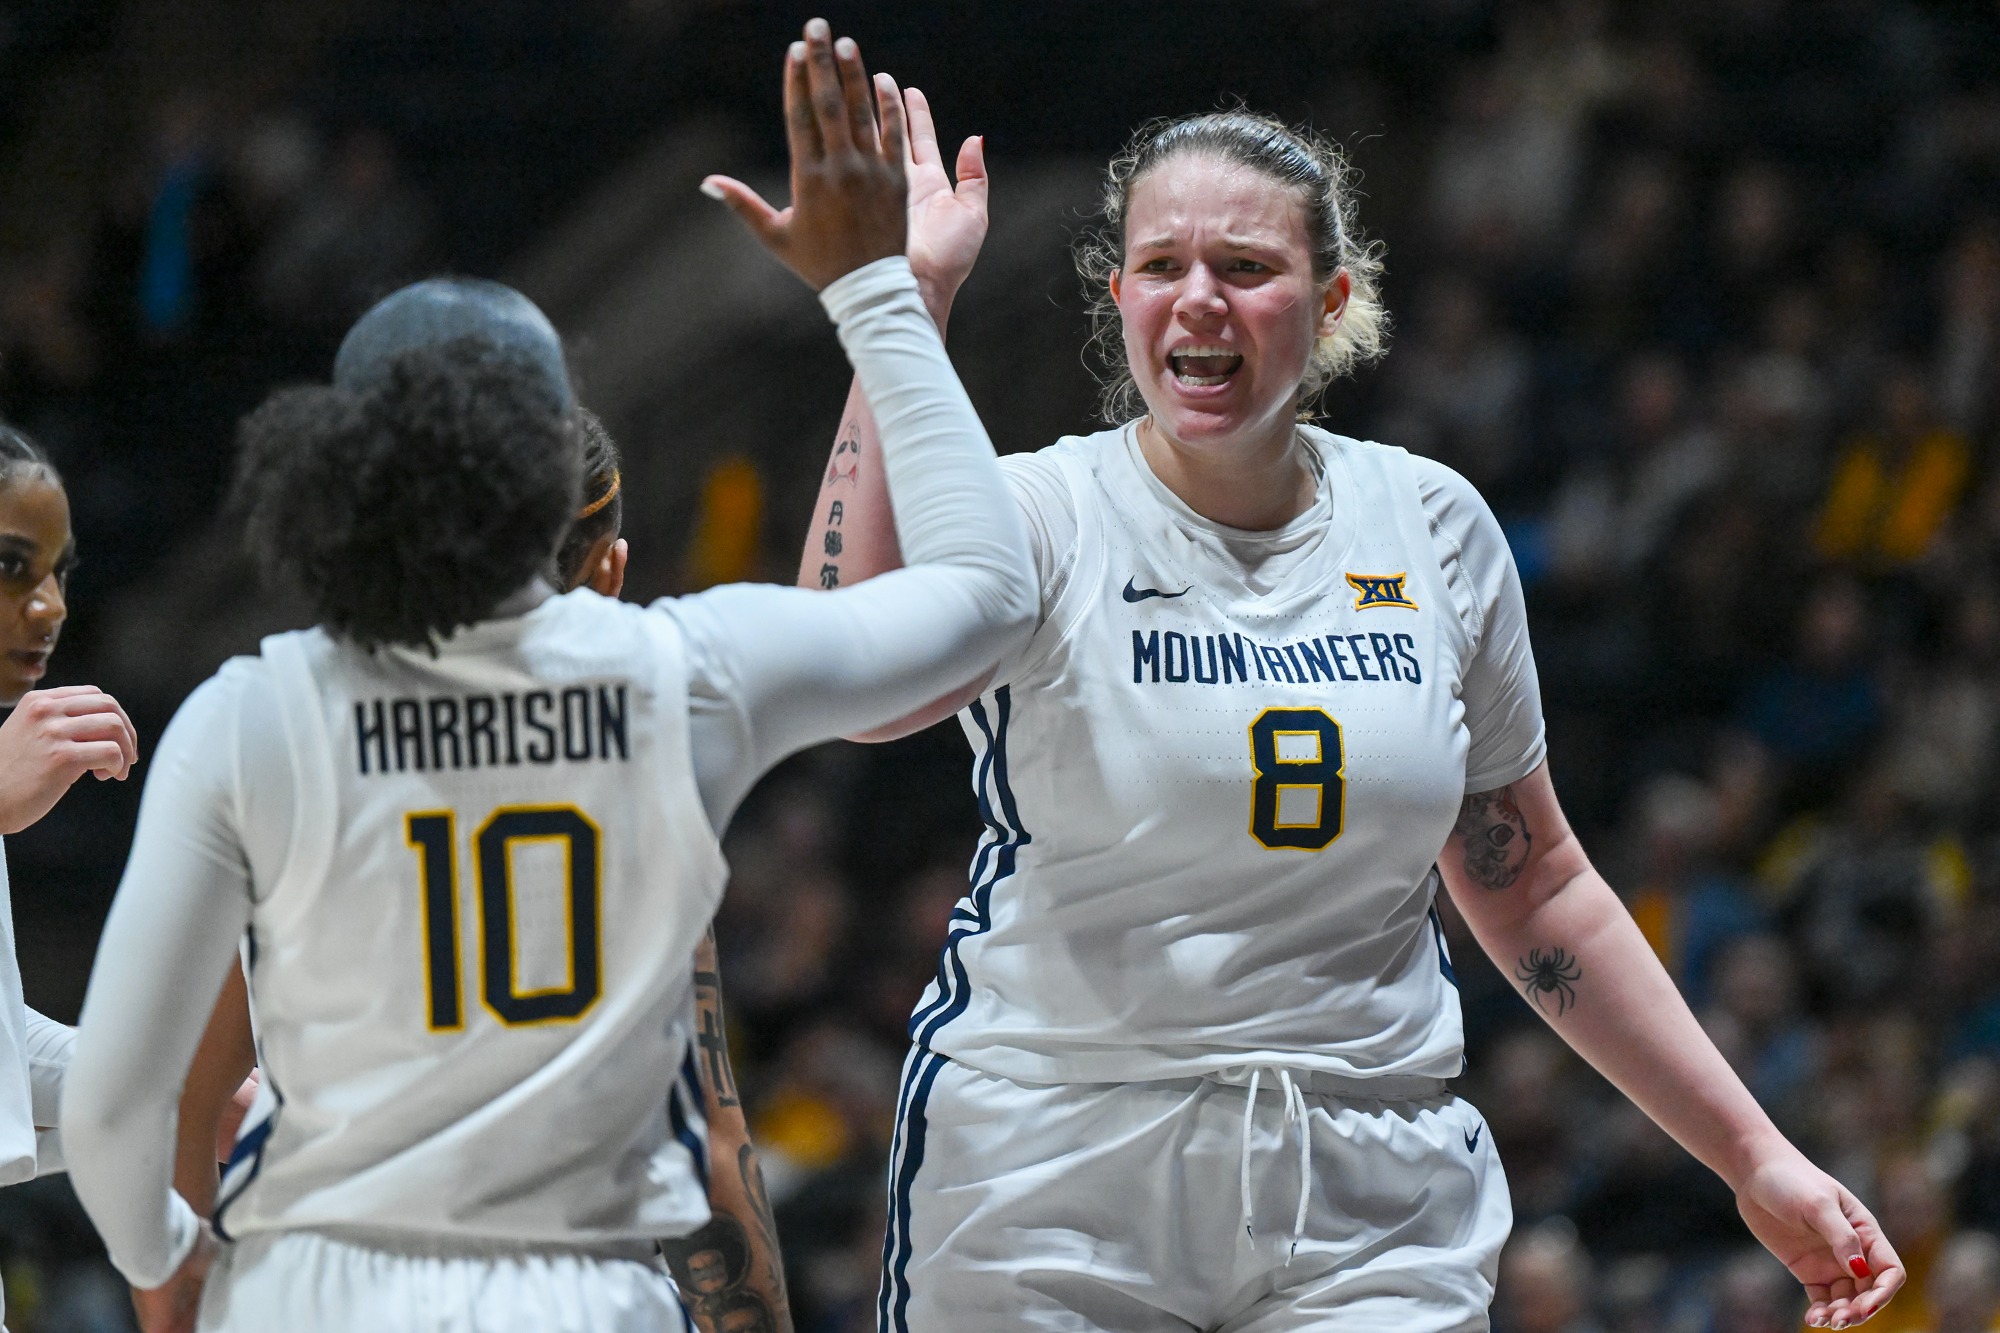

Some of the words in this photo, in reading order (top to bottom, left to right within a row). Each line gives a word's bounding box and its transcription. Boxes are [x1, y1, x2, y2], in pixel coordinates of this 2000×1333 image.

[1347, 574, 1416, 608] XII
[1131, 629, 1423, 685] MOUNTAINEERS
[353, 683, 631, 776] HARRISON
[1247, 705, 1347, 852] 8
[404, 802, 604, 1034] 10
